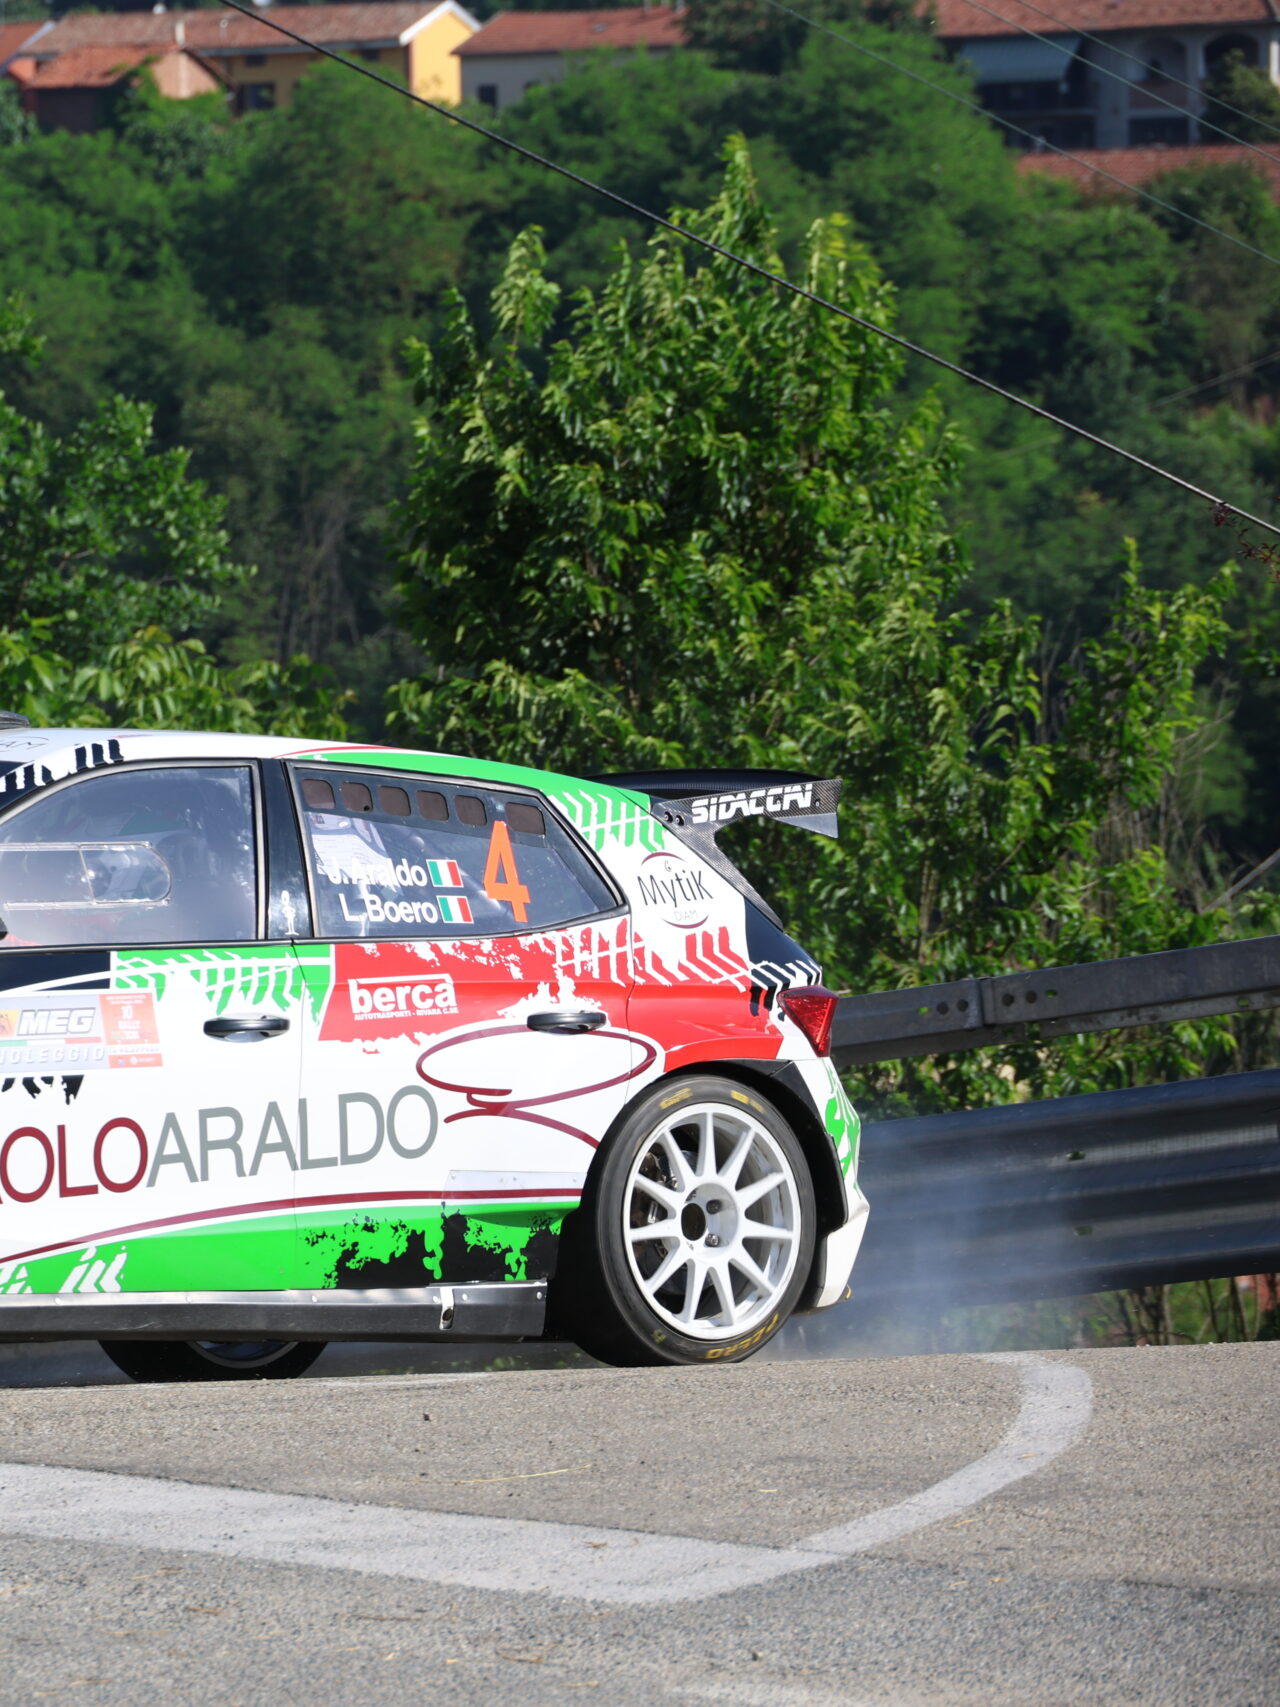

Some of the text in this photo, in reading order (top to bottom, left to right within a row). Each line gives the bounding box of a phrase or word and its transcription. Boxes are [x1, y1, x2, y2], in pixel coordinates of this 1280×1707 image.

[483, 820, 531, 923] 4
[347, 977, 457, 1014] berca
[17, 1007, 96, 1036] MEG
